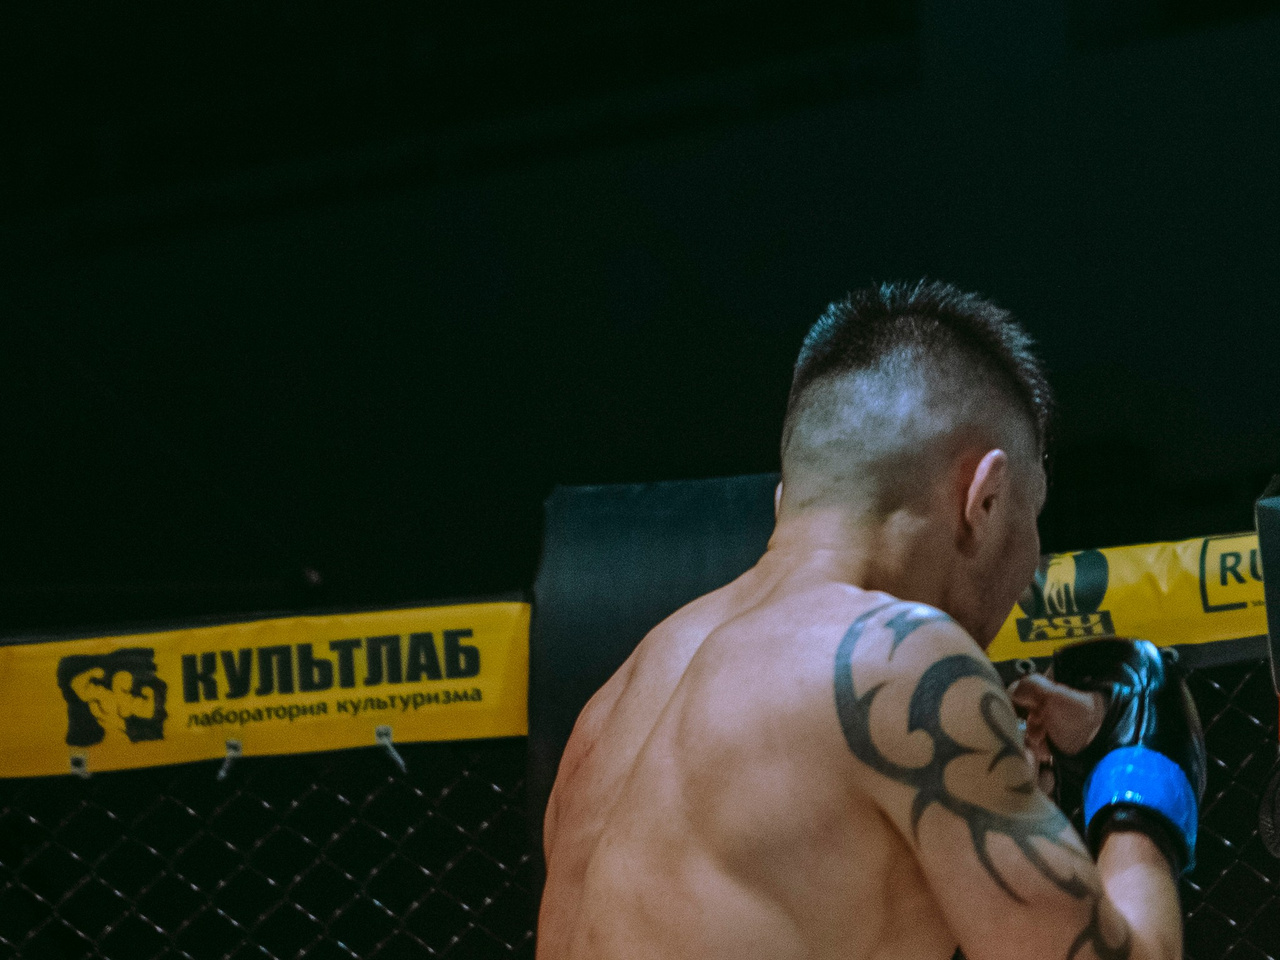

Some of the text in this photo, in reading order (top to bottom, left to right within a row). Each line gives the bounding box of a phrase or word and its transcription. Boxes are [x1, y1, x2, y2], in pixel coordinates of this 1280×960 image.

[181, 628, 482, 703] КУЛЬТЛАБ
[187, 687, 483, 729] лаборатория культуризма
